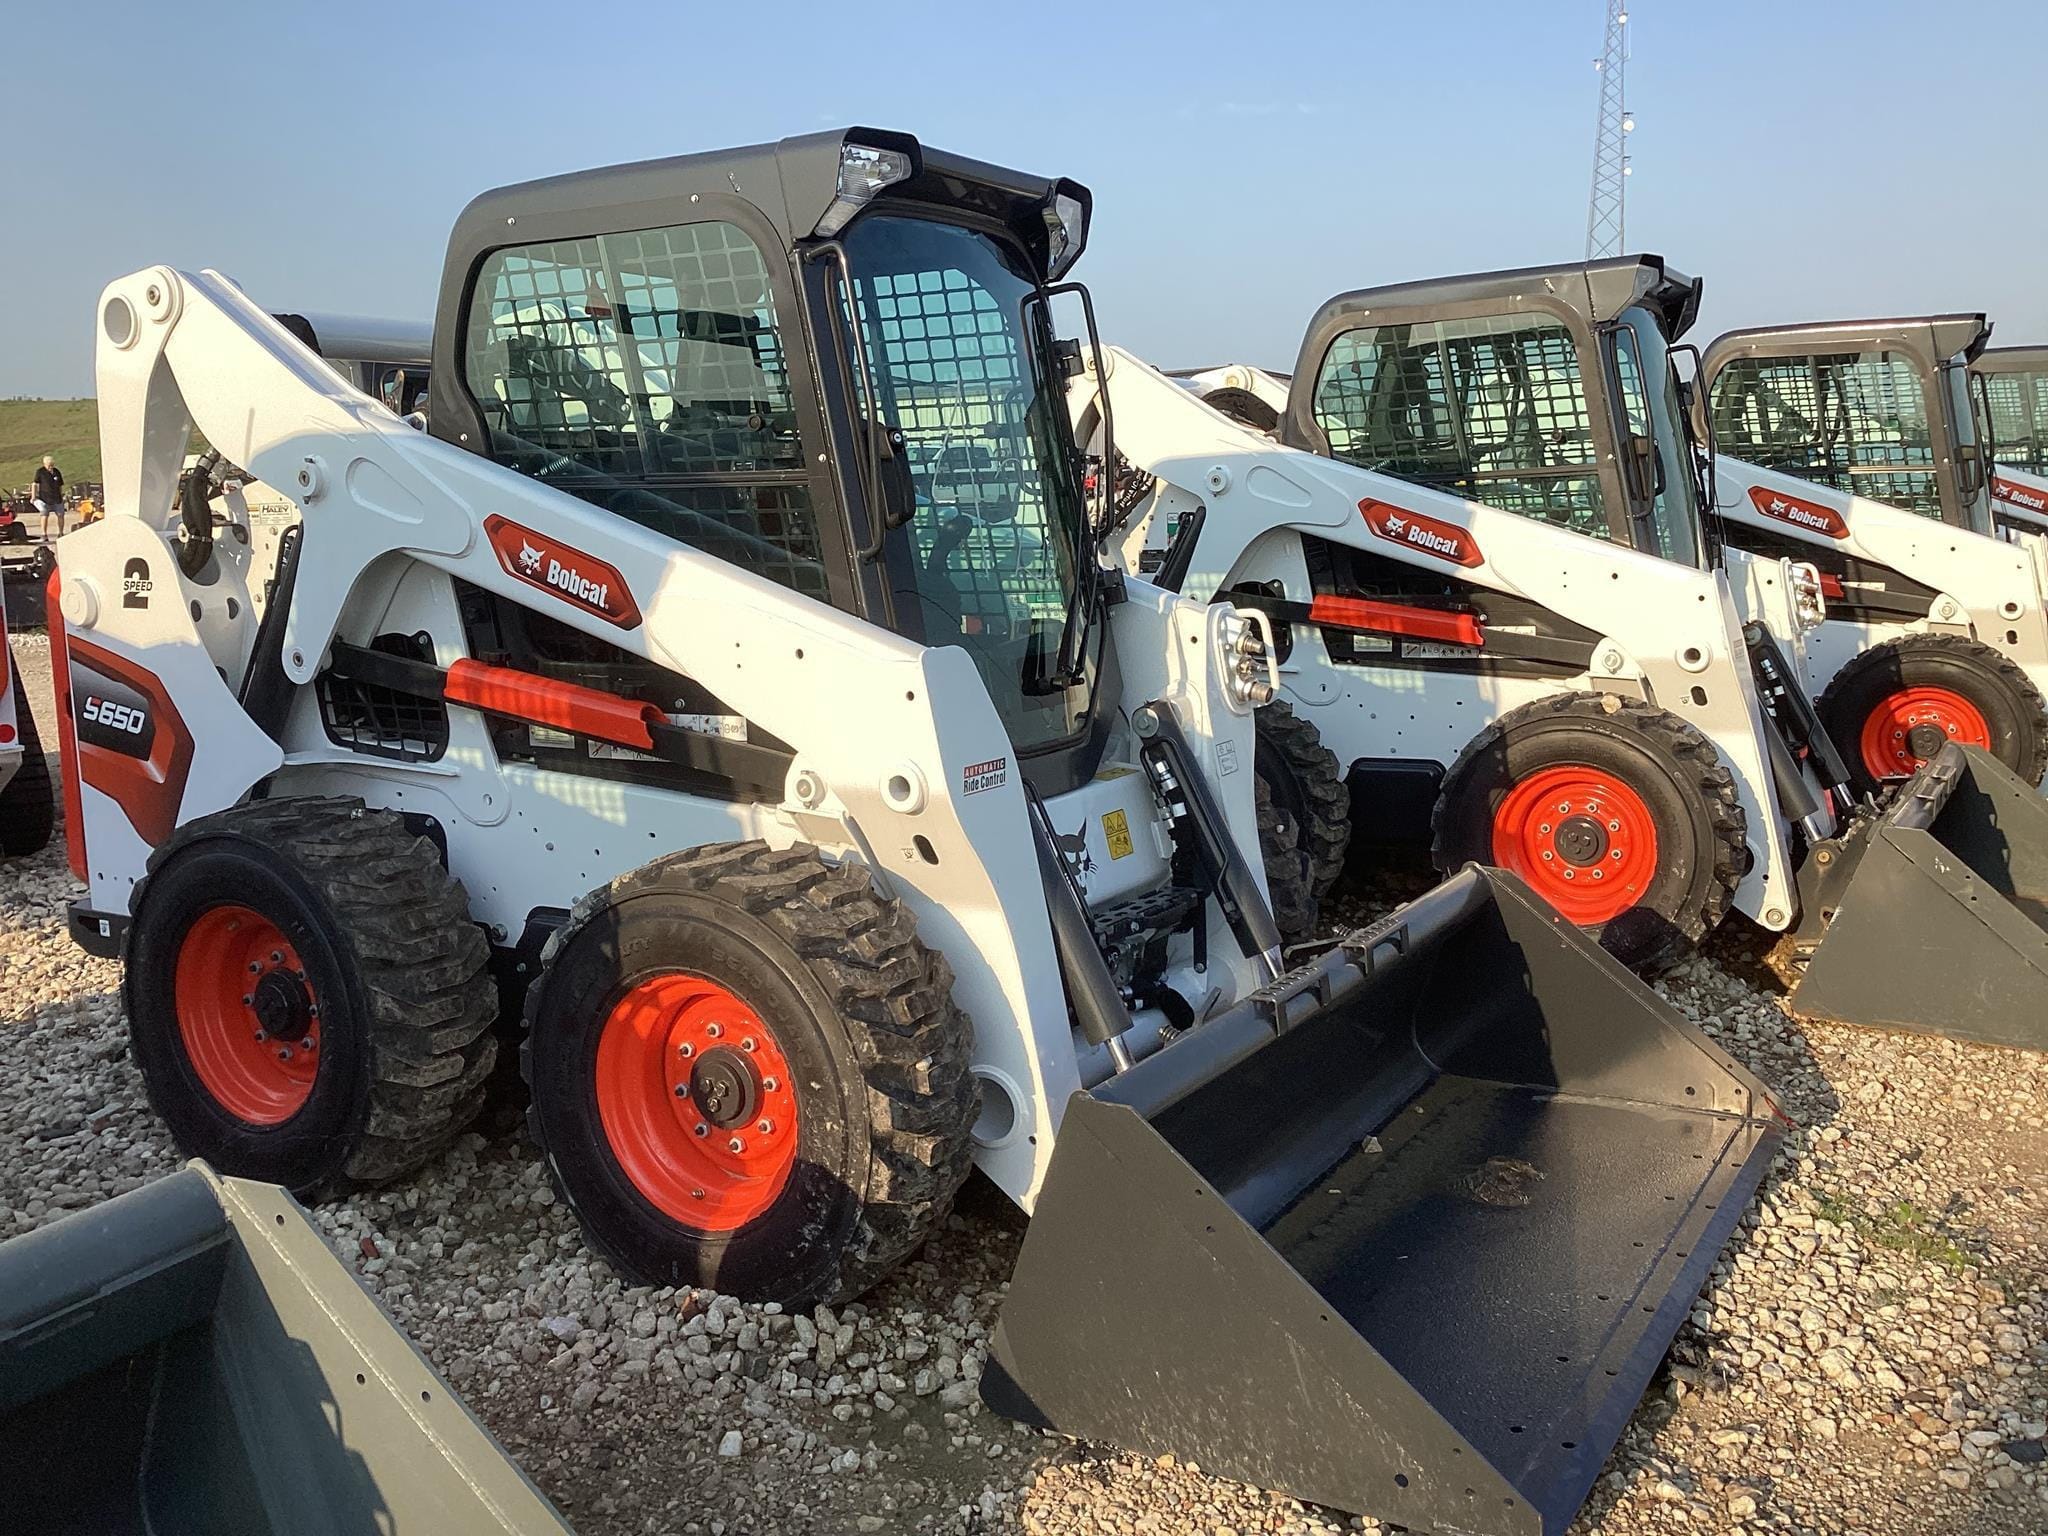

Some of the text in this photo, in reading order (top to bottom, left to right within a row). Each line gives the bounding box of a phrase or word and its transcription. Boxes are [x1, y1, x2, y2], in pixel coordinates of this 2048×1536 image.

[2010, 490, 2045, 509] Bobcat
[1788, 506, 1829, 530] Bobcat
[1408, 525, 1457, 555] Bobcat
[123, 557, 150, 609] 2
[123, 580, 153, 591] SPEED
[547, 559, 608, 608] Bobcat
[83, 696, 145, 735] S650
[965, 760, 1005, 778] AUTOMATIC
[963, 770, 1006, 793] Ride Control
